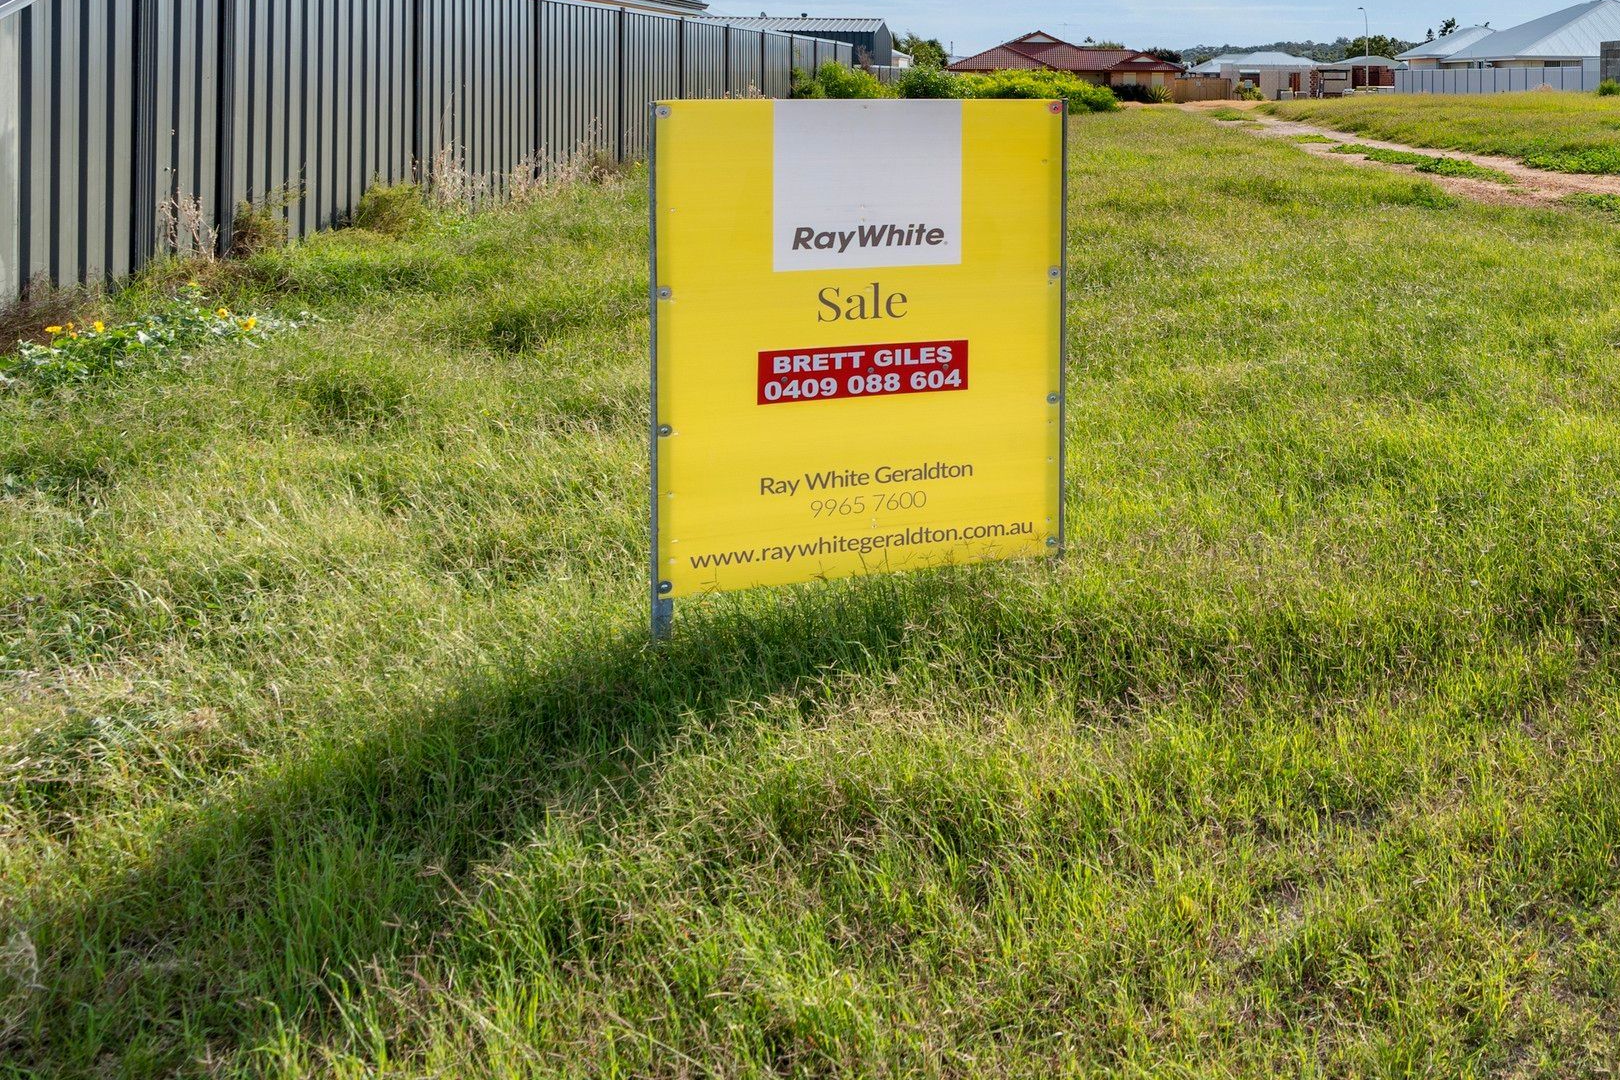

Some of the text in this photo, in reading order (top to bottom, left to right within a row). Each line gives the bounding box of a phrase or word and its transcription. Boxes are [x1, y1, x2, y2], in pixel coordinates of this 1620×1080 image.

[817, 283, 908, 322] Sale
[773, 346, 953, 374] BRETT GILES
[763, 368, 962, 401] 0409 088 604
[759, 460, 974, 496] Ray White Geraldton
[810, 491, 927, 518] 9965 7600
[690, 521, 1034, 569] www.raywhitegeraldton.com.au
